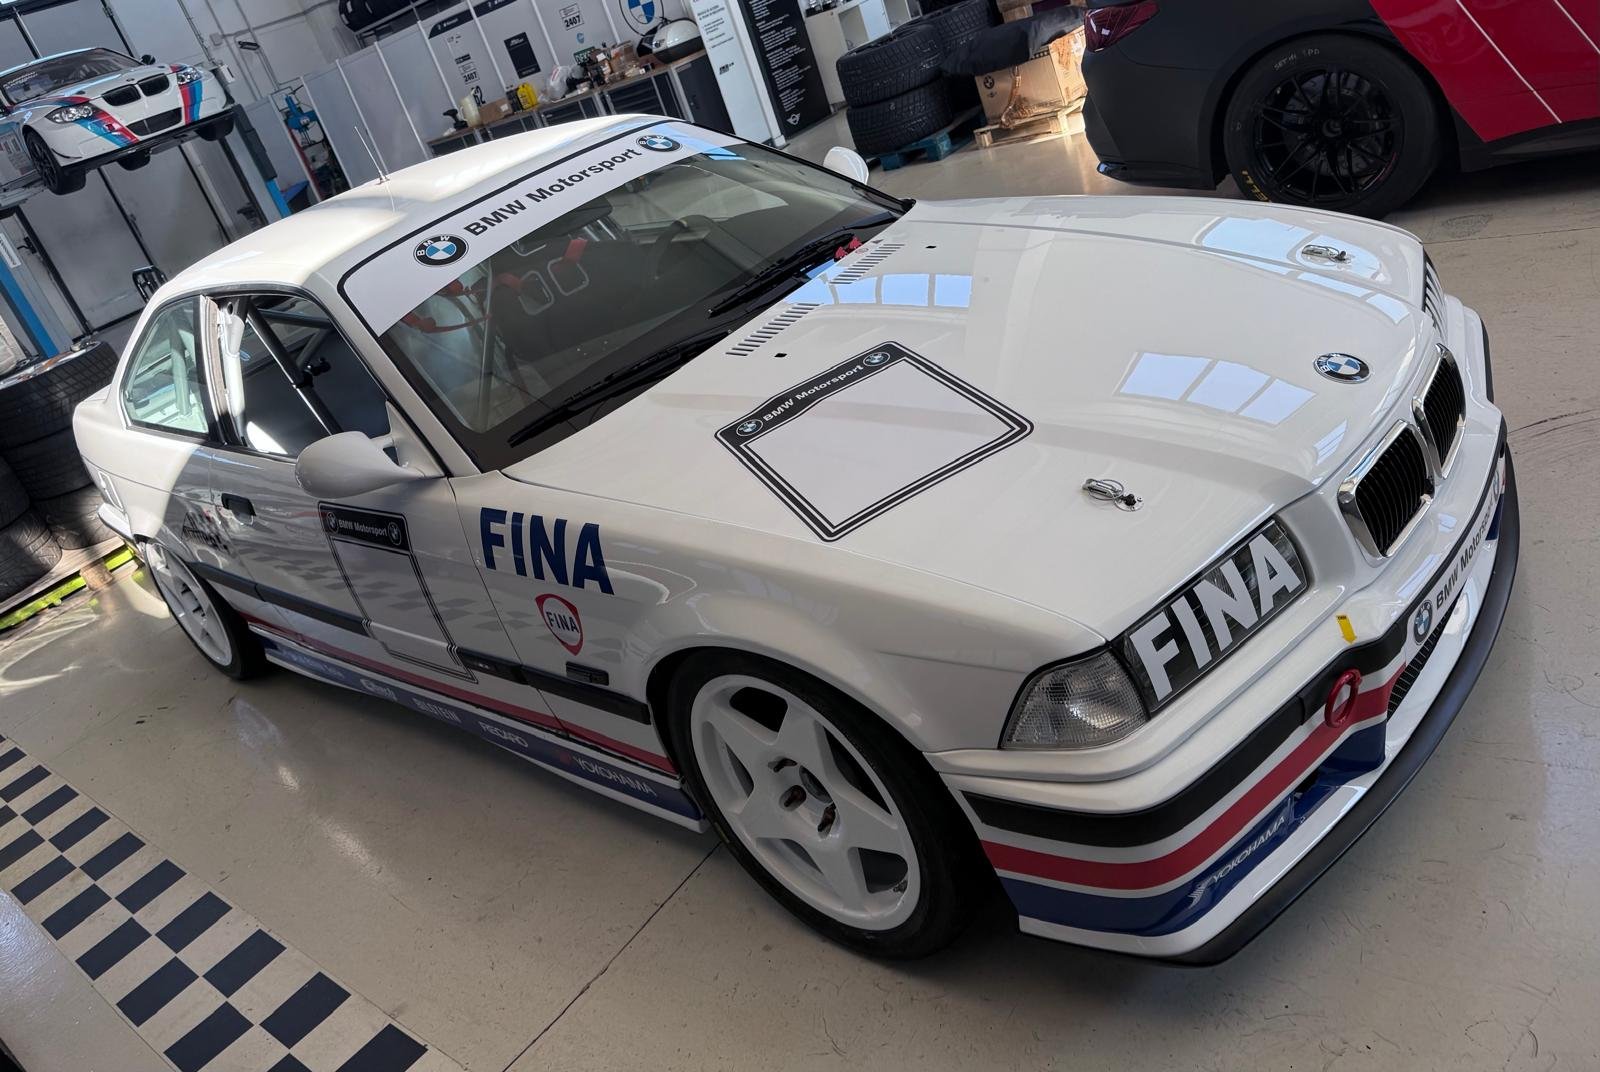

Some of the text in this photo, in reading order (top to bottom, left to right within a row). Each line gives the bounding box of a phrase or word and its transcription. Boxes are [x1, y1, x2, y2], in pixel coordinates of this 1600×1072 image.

[563, 15, 580, 28] 2407
[464, 148, 643, 236] BMW Motorsport
[762, 364, 865, 422] BMW Motorsport
[339, 519, 388, 537] BMW Motorsport
[480, 507, 615, 596] FINA
[1436, 566, 1459, 611] BMW
[546, 610, 580, 634] FINA
[1129, 533, 1302, 702] FINA
[479, 721, 529, 748] RECARO
[573, 755, 658, 797] YOKOHAMA
[1212, 816, 1286, 884] YOKOHAMA
